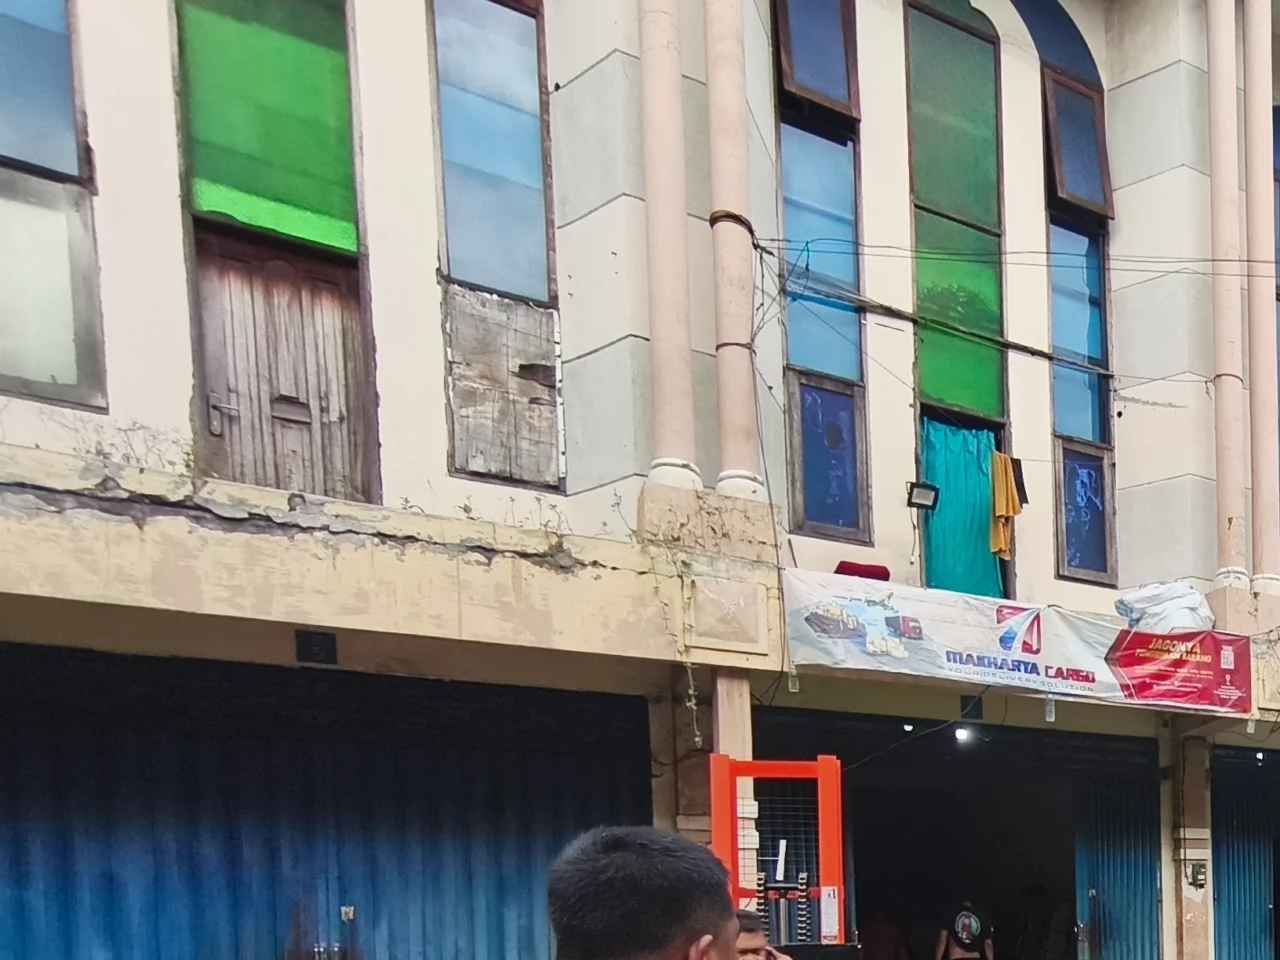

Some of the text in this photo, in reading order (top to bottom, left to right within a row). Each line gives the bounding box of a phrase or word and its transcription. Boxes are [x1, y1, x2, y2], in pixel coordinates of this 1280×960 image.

[1148, 638, 1200, 653] JAGONYA
[945, 650, 1096, 683] MAKHARYA CARGO
[947, 666, 1095, 692] YOUR DELIVERY SOLUTION
